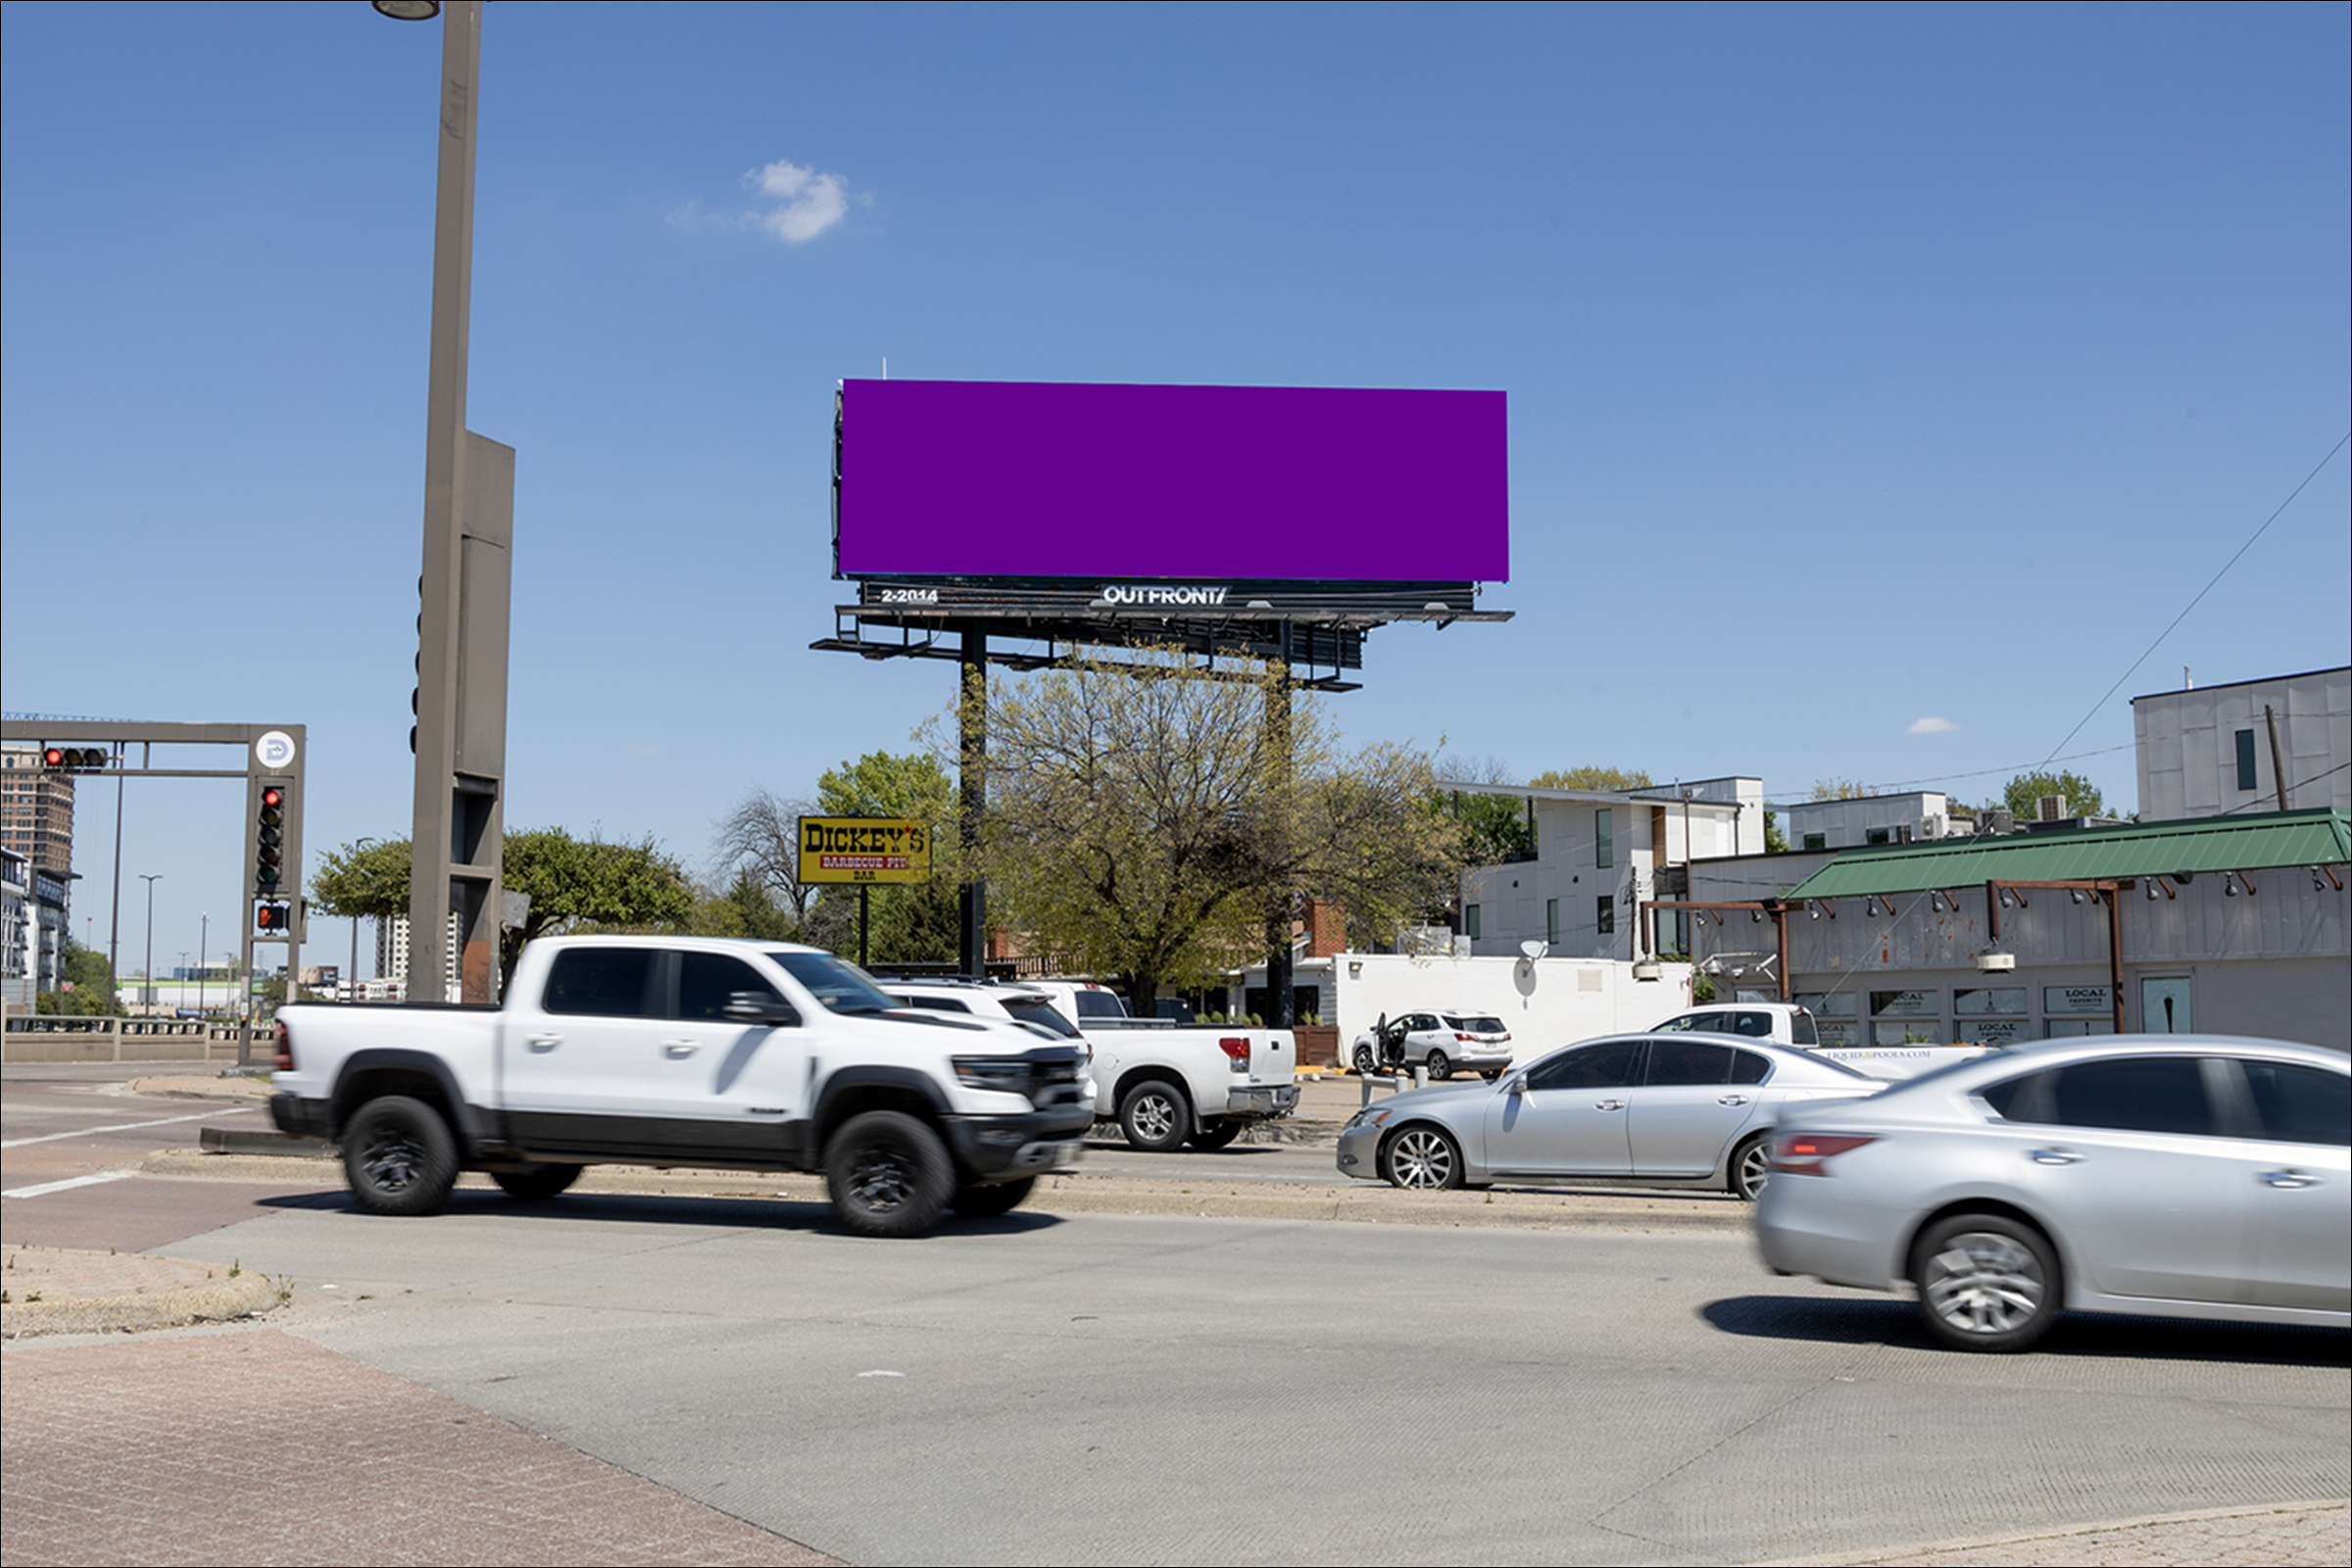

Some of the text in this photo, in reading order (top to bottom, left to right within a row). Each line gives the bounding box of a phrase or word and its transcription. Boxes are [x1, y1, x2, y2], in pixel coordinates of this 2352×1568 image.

[881, 589, 939, 603] 2-2014
[822, 856, 907, 869] BARBECUE PIT
[854, 870, 877, 881] BAR
[2065, 989, 2107, 998] LOCAL
